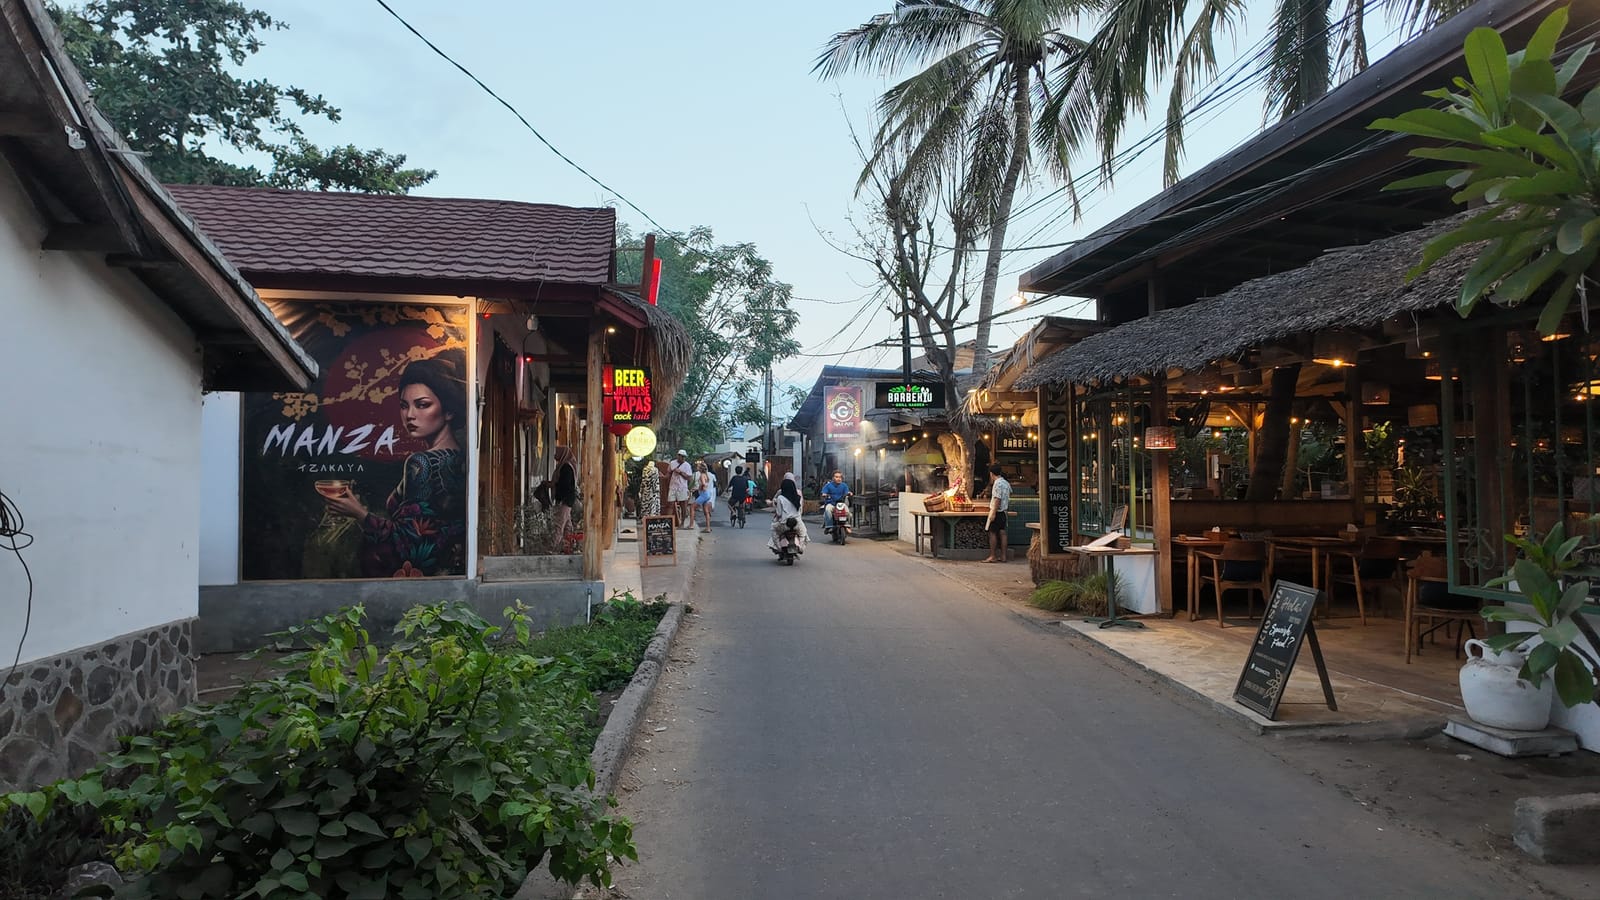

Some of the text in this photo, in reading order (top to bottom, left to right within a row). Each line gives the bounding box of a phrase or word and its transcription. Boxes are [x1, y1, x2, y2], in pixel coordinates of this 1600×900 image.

[615, 369, 645, 387] BEER
[613, 386, 649, 396] JAPANESE
[613, 396, 651, 412] TAPAS
[263, 423, 400, 457] MANZA
[1049, 493, 1069, 501] TAPAS
[1059, 505, 1070, 547] CHURROS
